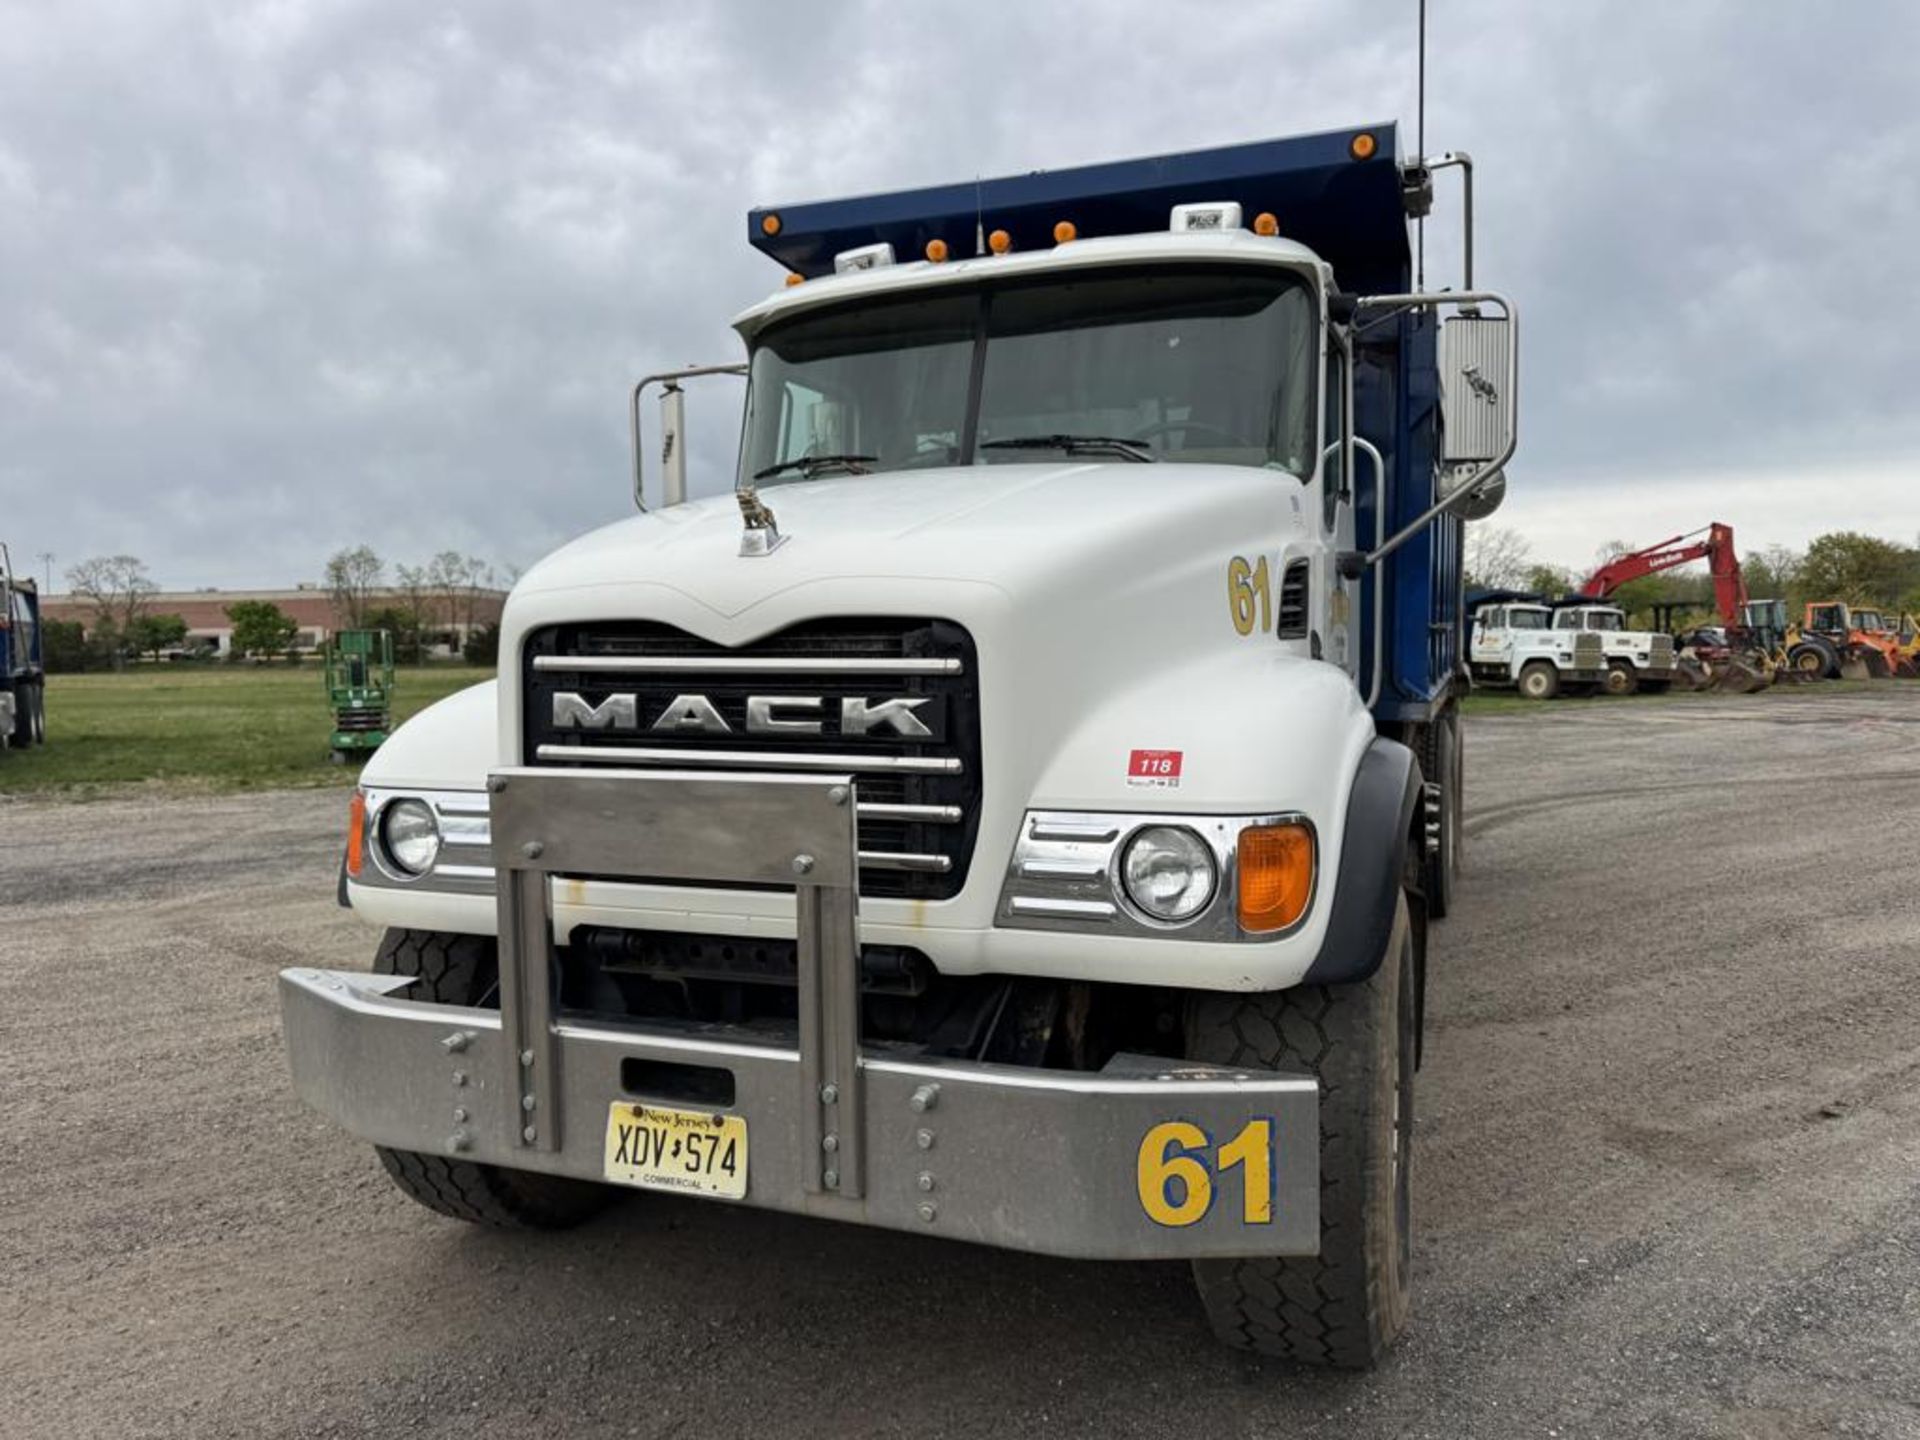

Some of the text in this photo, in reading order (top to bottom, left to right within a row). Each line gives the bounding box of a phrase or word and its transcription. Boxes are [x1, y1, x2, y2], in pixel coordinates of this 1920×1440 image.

[1228, 555, 1272, 636] 61
[552, 692, 933, 736] MACK
[1141, 759, 1172, 773] 118
[644, 1109, 711, 1130] New Jersey
[615, 1124, 736, 1177] XDV S74
[1137, 1117, 1275, 1228] 61
[643, 1173, 702, 1190] COMMERCIAL
